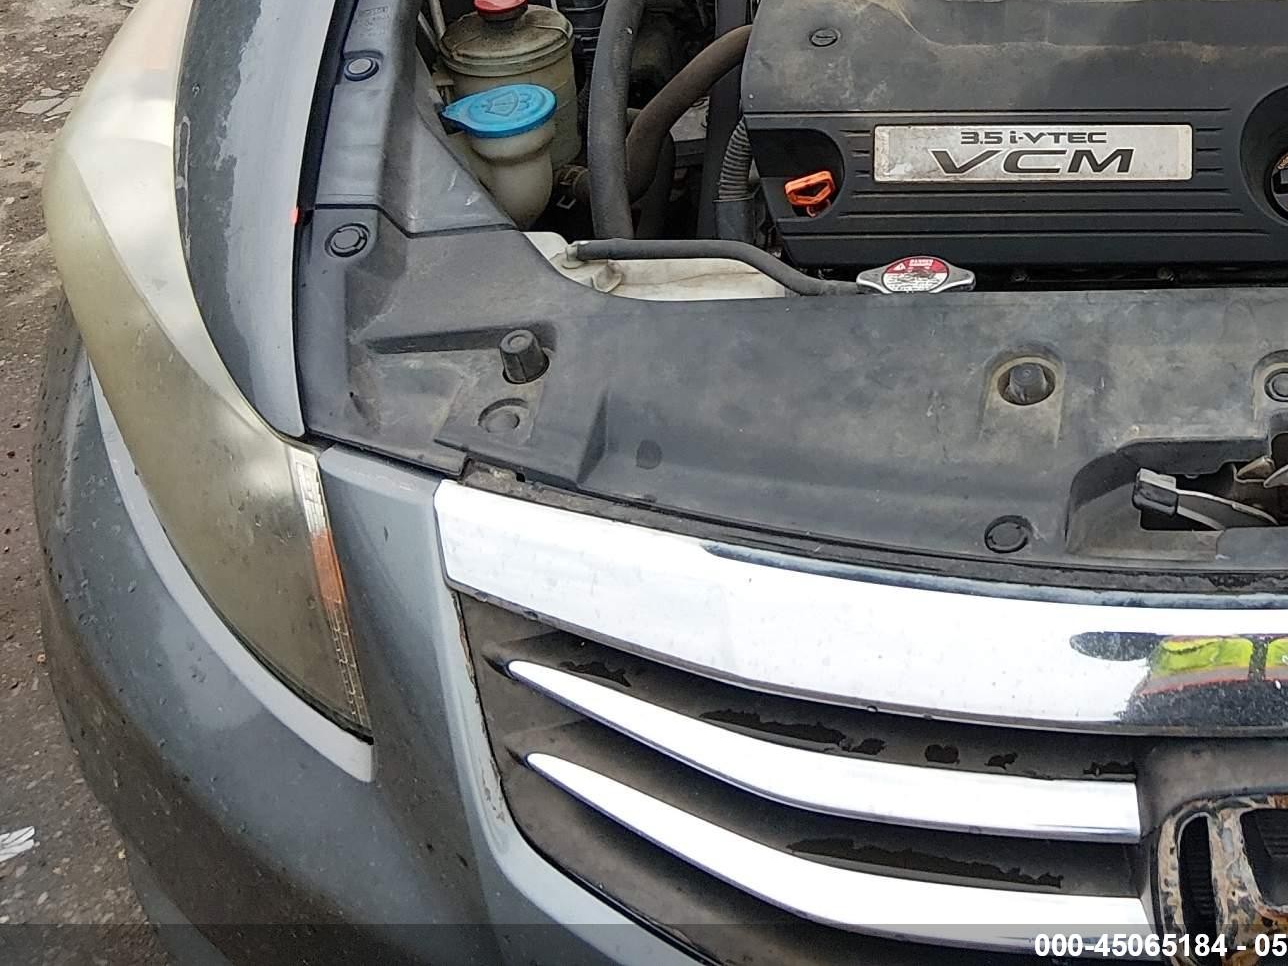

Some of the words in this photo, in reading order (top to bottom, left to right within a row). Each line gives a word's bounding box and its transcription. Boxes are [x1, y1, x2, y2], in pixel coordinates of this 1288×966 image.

[960, 130, 1003, 145] 3.5
[1009, 130, 1107, 144] i-VTEC
[930, 147, 1135, 174] VCM
